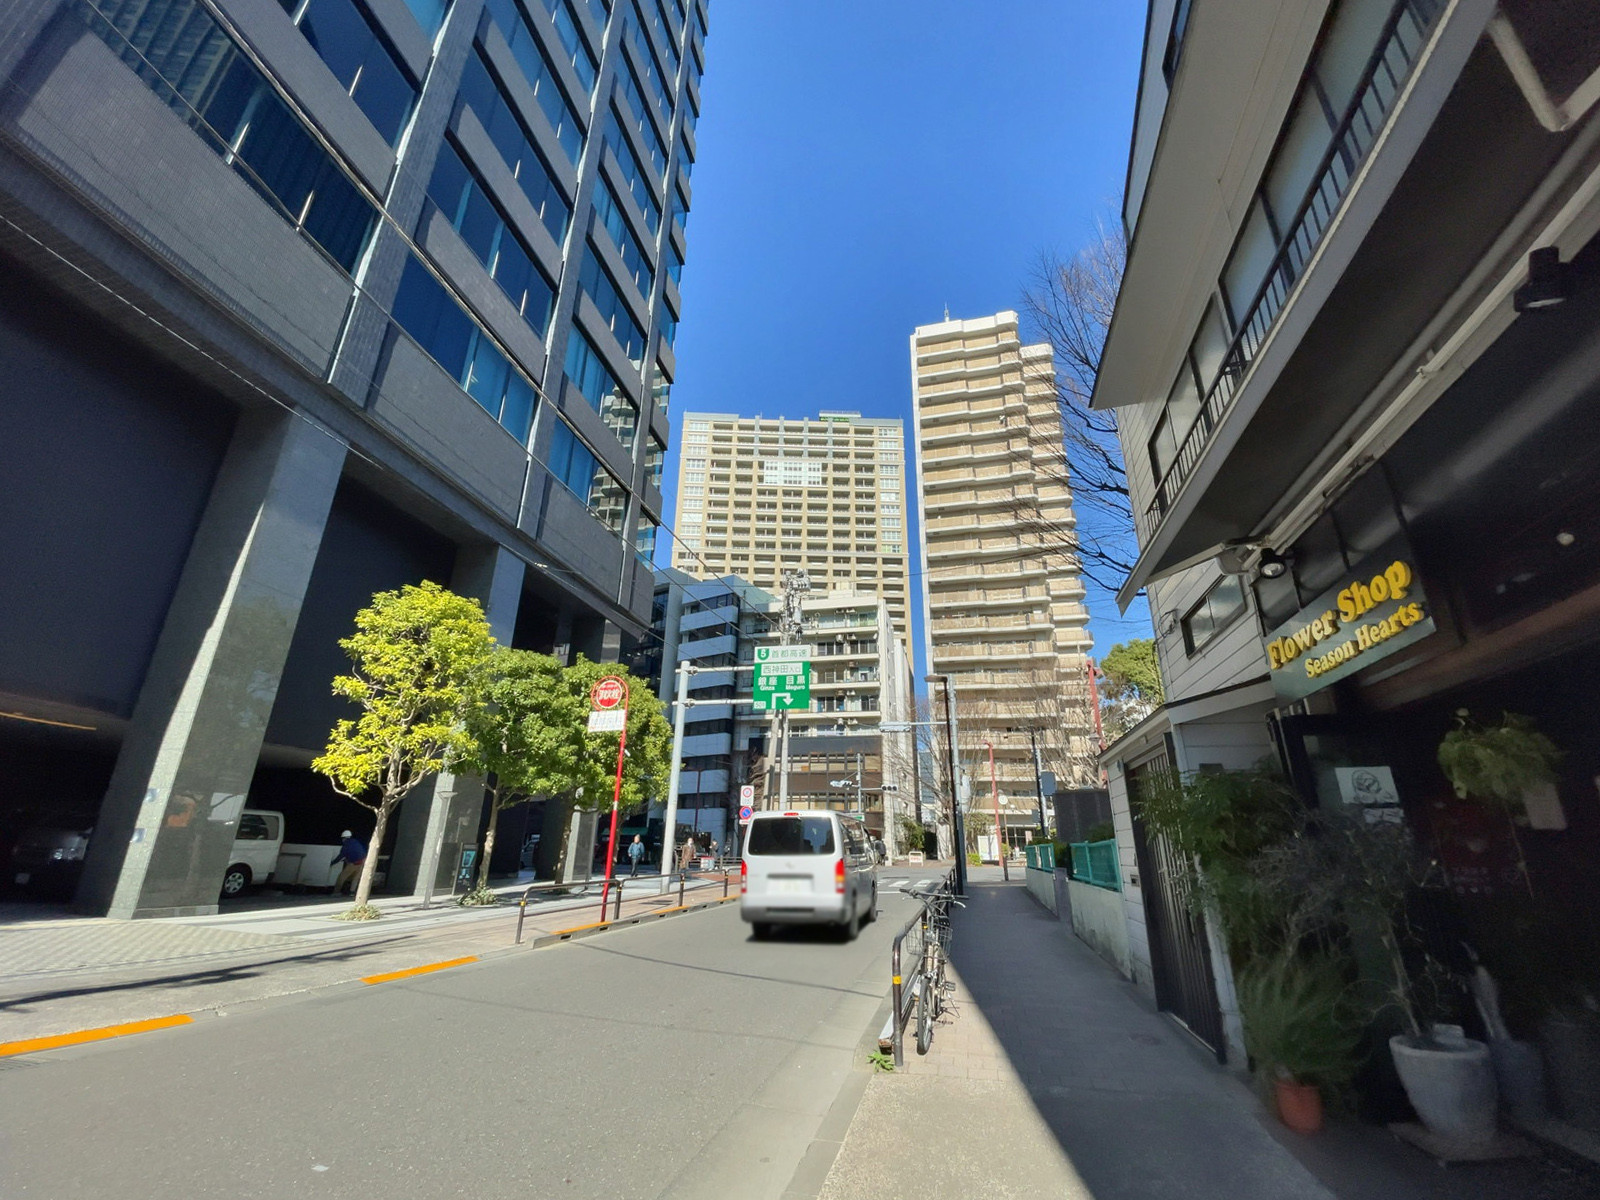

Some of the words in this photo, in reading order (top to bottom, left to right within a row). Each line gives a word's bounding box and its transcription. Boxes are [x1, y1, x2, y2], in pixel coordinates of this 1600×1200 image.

[1266, 609, 1337, 670] Flower
[1337, 560, 1412, 623] Shop
[1304, 640, 1358, 679] Season
[1354, 602, 1423, 651] Hearts
